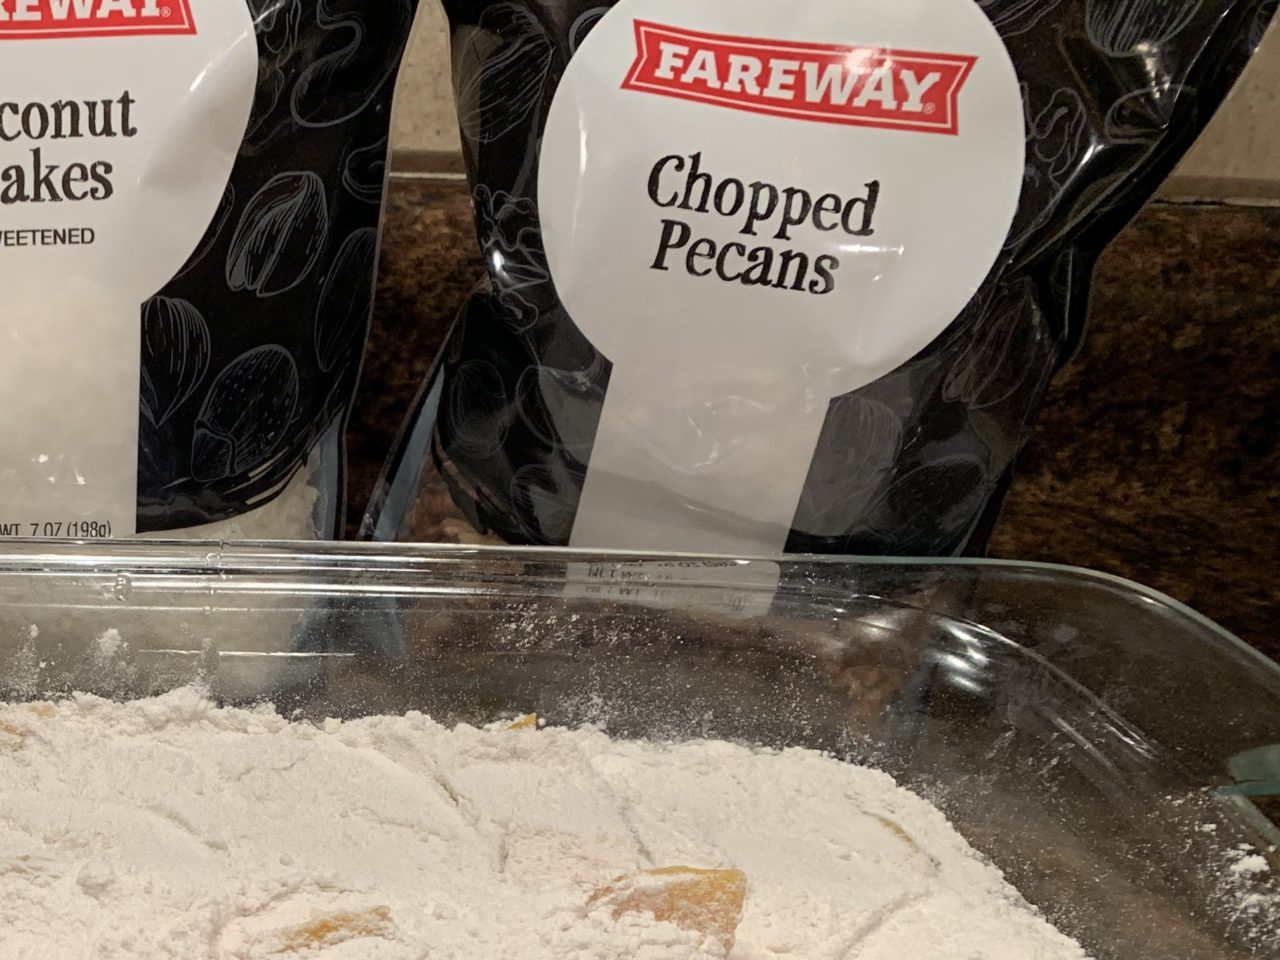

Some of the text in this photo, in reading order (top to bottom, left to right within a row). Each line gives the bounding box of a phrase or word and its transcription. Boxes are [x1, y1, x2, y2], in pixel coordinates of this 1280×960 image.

[653, 41, 939, 113] FAREWAY
[646, 151, 881, 239] Chopped
[649, 218, 841, 295] Pecans
[30, 522, 40, 537] 7
